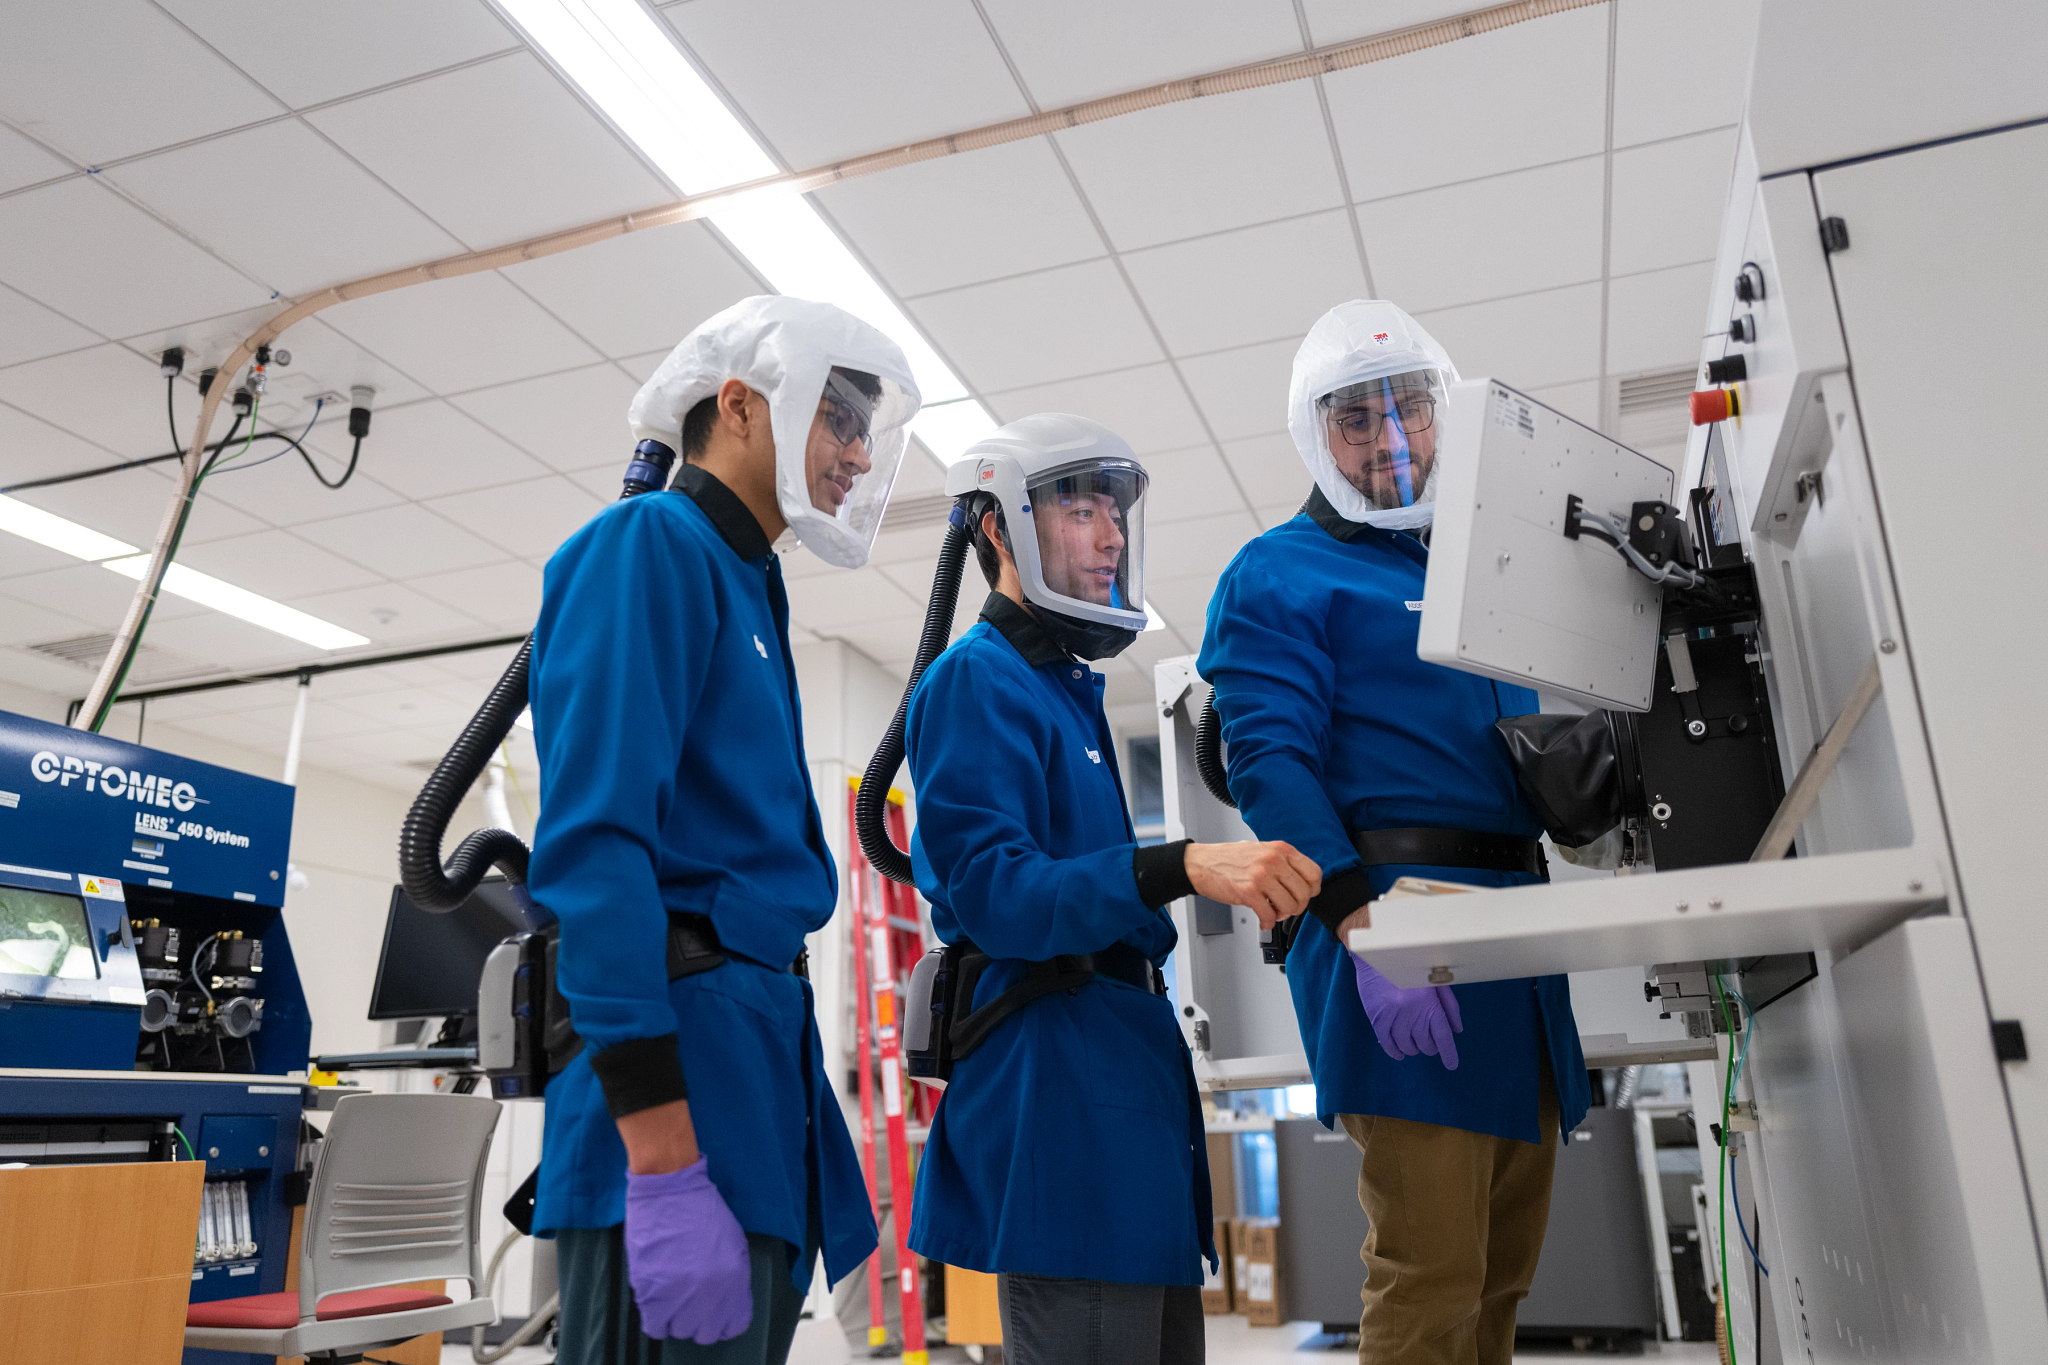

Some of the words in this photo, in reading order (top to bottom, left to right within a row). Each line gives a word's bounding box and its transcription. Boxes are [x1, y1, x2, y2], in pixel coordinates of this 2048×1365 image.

[982, 469, 994, 480] 3M
[31, 751, 199, 812] OPTOMEC
[177, 821, 203, 839] 450
[204, 826, 250, 849] System
